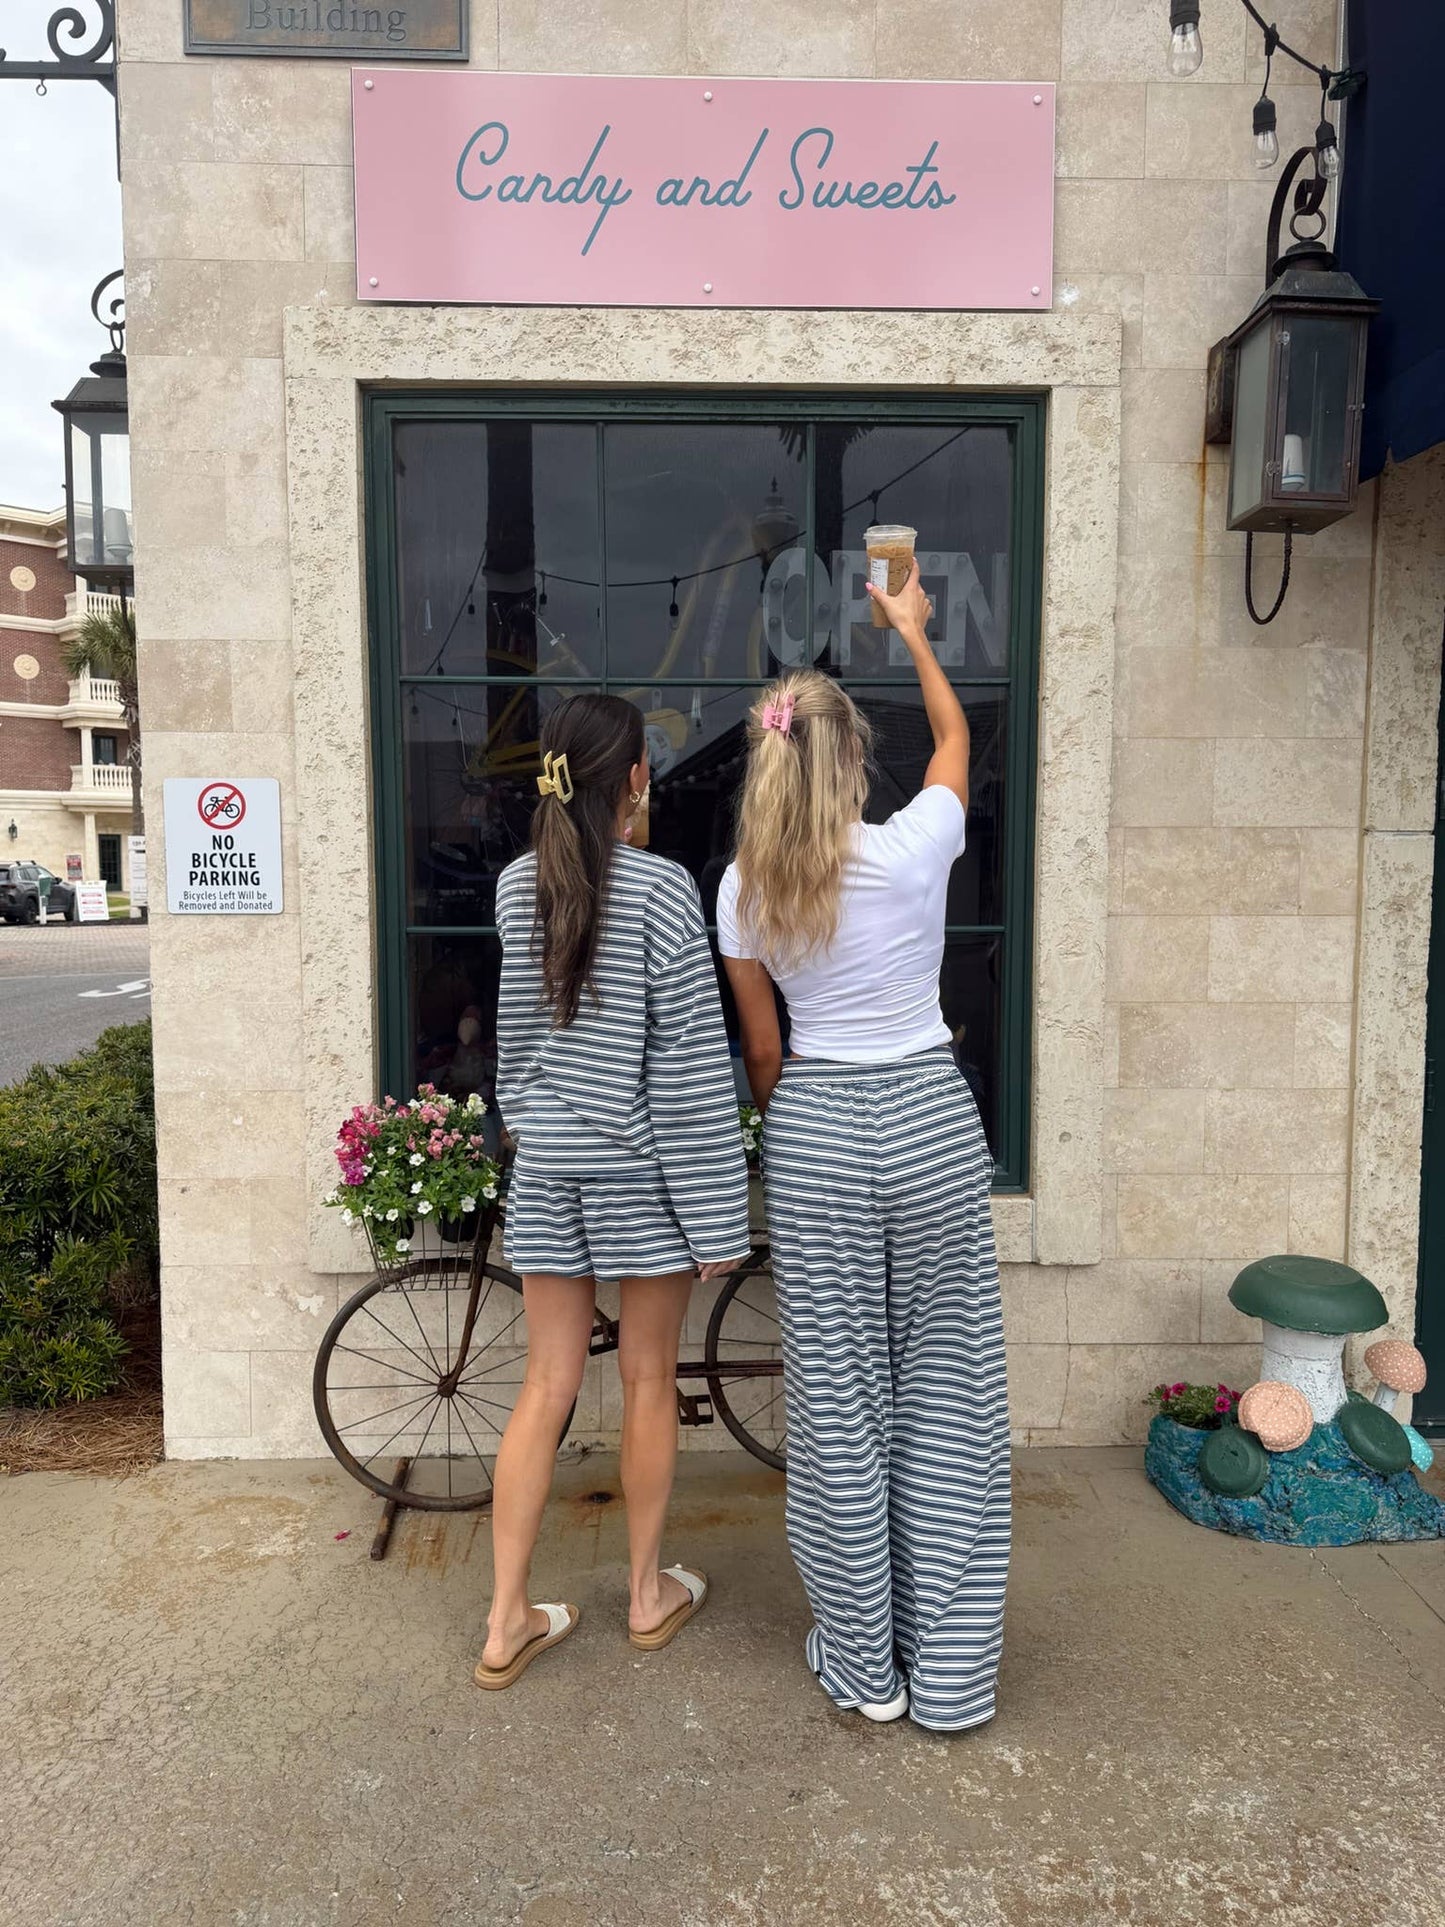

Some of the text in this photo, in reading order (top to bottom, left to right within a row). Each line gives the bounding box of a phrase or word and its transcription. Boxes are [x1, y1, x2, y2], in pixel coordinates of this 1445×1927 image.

[246, 0, 407, 42] Building
[457, 122, 956, 256] Candy and Sweets
[763, 548, 1008, 667] OPEN
[212, 835, 235, 850] NO
[192, 853, 257, 868] BICYCLE
[189, 871, 261, 886] PARKING
[183, 891, 267, 902] Bicycles Left Will be
[179, 901, 273, 910] Removed and Donated
